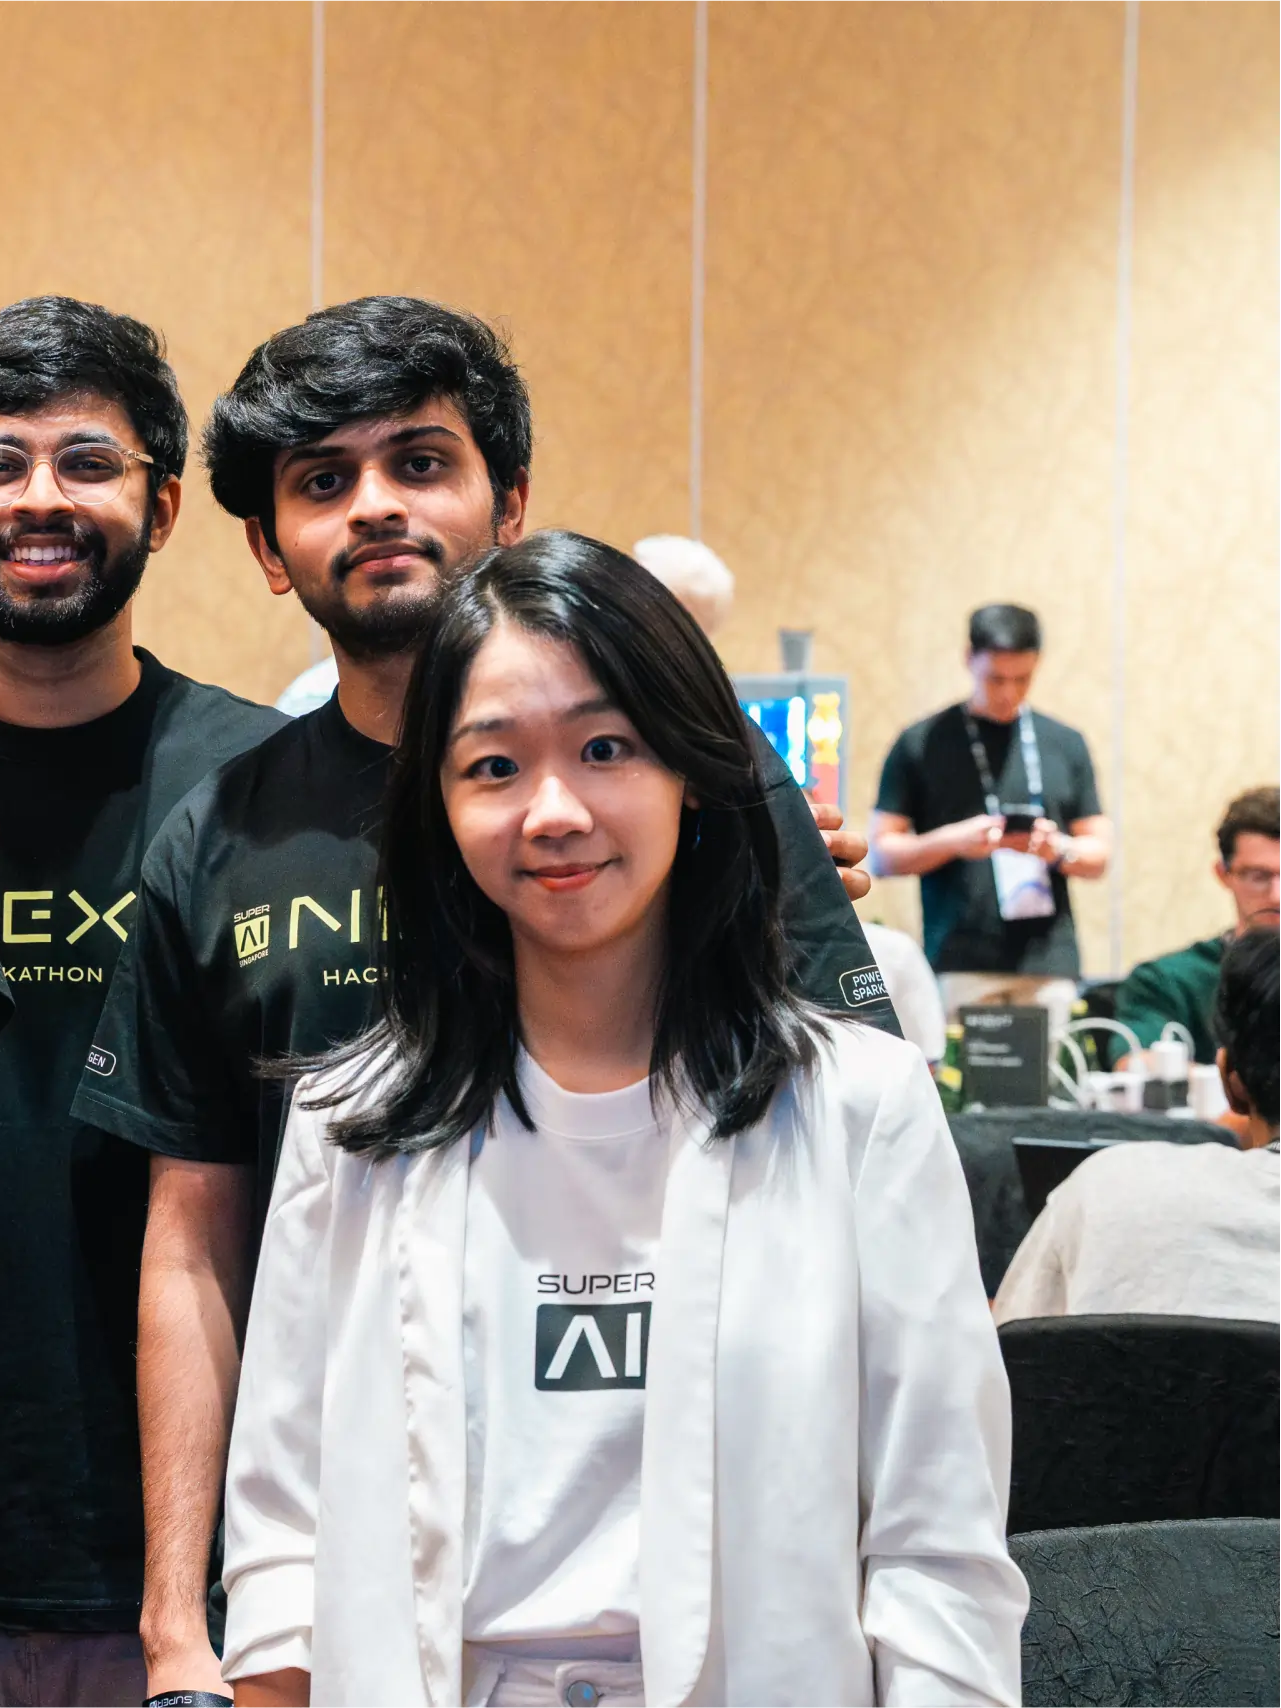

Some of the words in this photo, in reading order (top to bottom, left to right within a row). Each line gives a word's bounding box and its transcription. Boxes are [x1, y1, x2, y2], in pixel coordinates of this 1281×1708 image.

[233, 904, 270, 924] SUPER
[239, 920, 265, 953] AI
[239, 949, 269, 968] SINGAPORE
[88, 1051, 106, 1068] GEN
[537, 1272, 655, 1294] SUPER
[543, 1310, 644, 1381] AI
